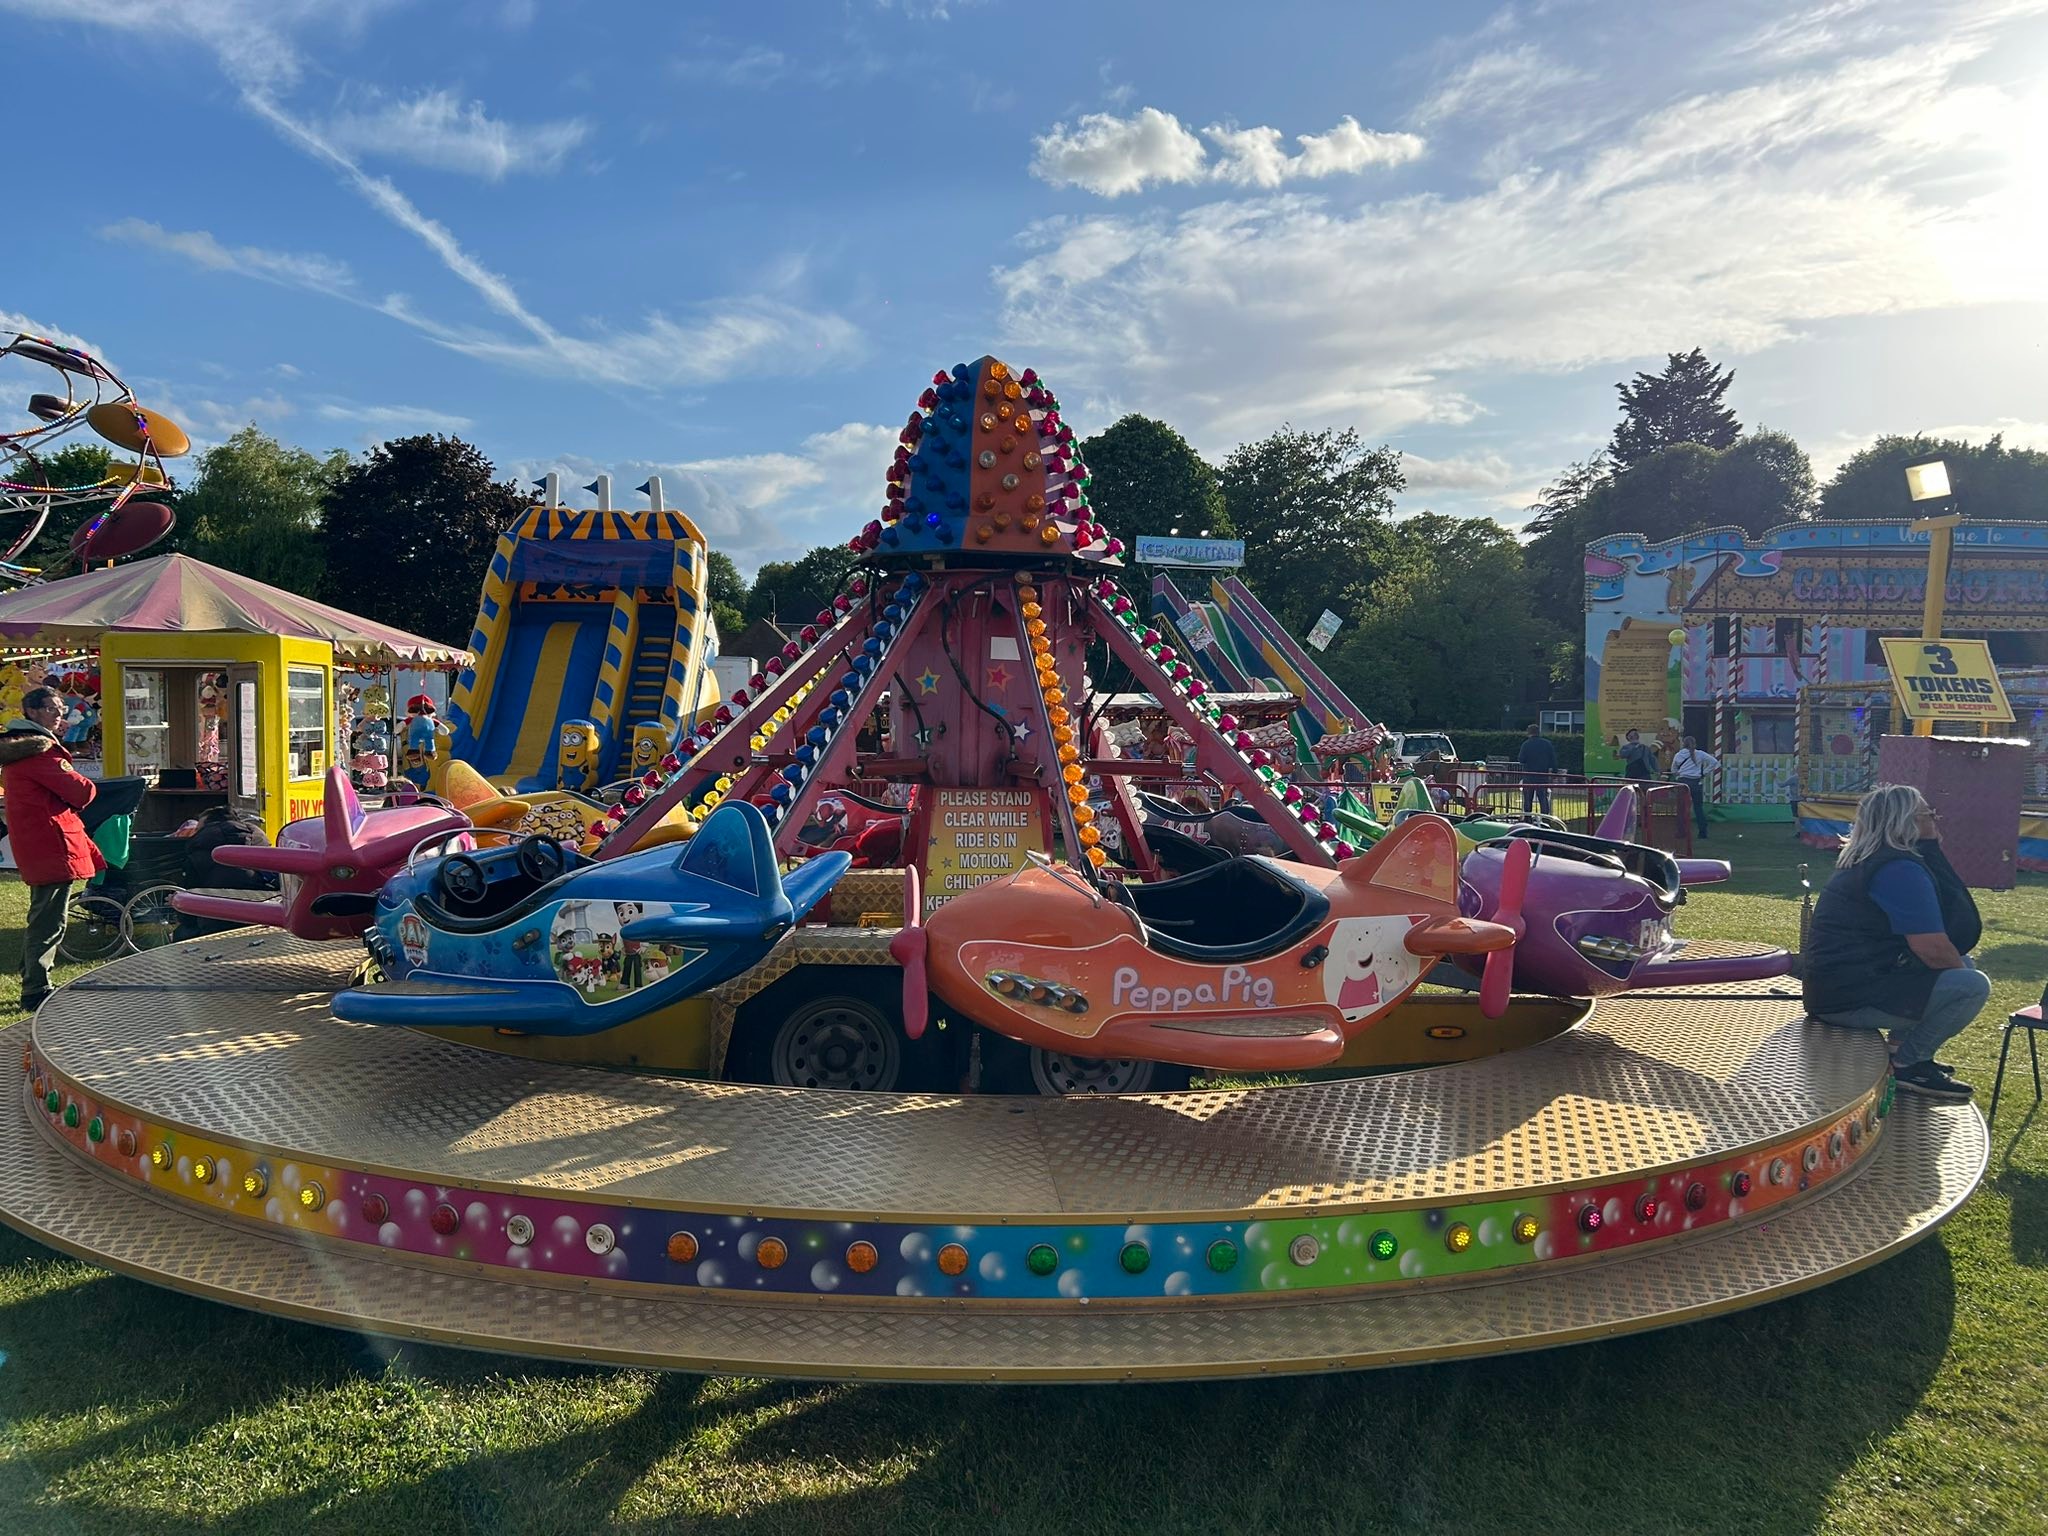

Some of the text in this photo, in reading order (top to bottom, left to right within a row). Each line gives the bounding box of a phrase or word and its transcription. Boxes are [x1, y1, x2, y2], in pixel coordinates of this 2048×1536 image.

[1984, 526, 2004, 545] To
[1792, 567, 1928, 601] CANDY
[1923, 643, 1959, 675] 3
[1904, 676, 1994, 694] TOKENS
[1919, 693, 1992, 704] PER PERSON
[940, 791, 1032, 806] PLEASE STAND
[290, 799, 310, 822] BUY
[944, 812, 1028, 827] CLEAR WHILE
[955, 832, 1017, 848] RIDE IS IN
[959, 853, 1013, 869] MOTION.
[1112, 965, 1277, 1012] Peppa Pig
